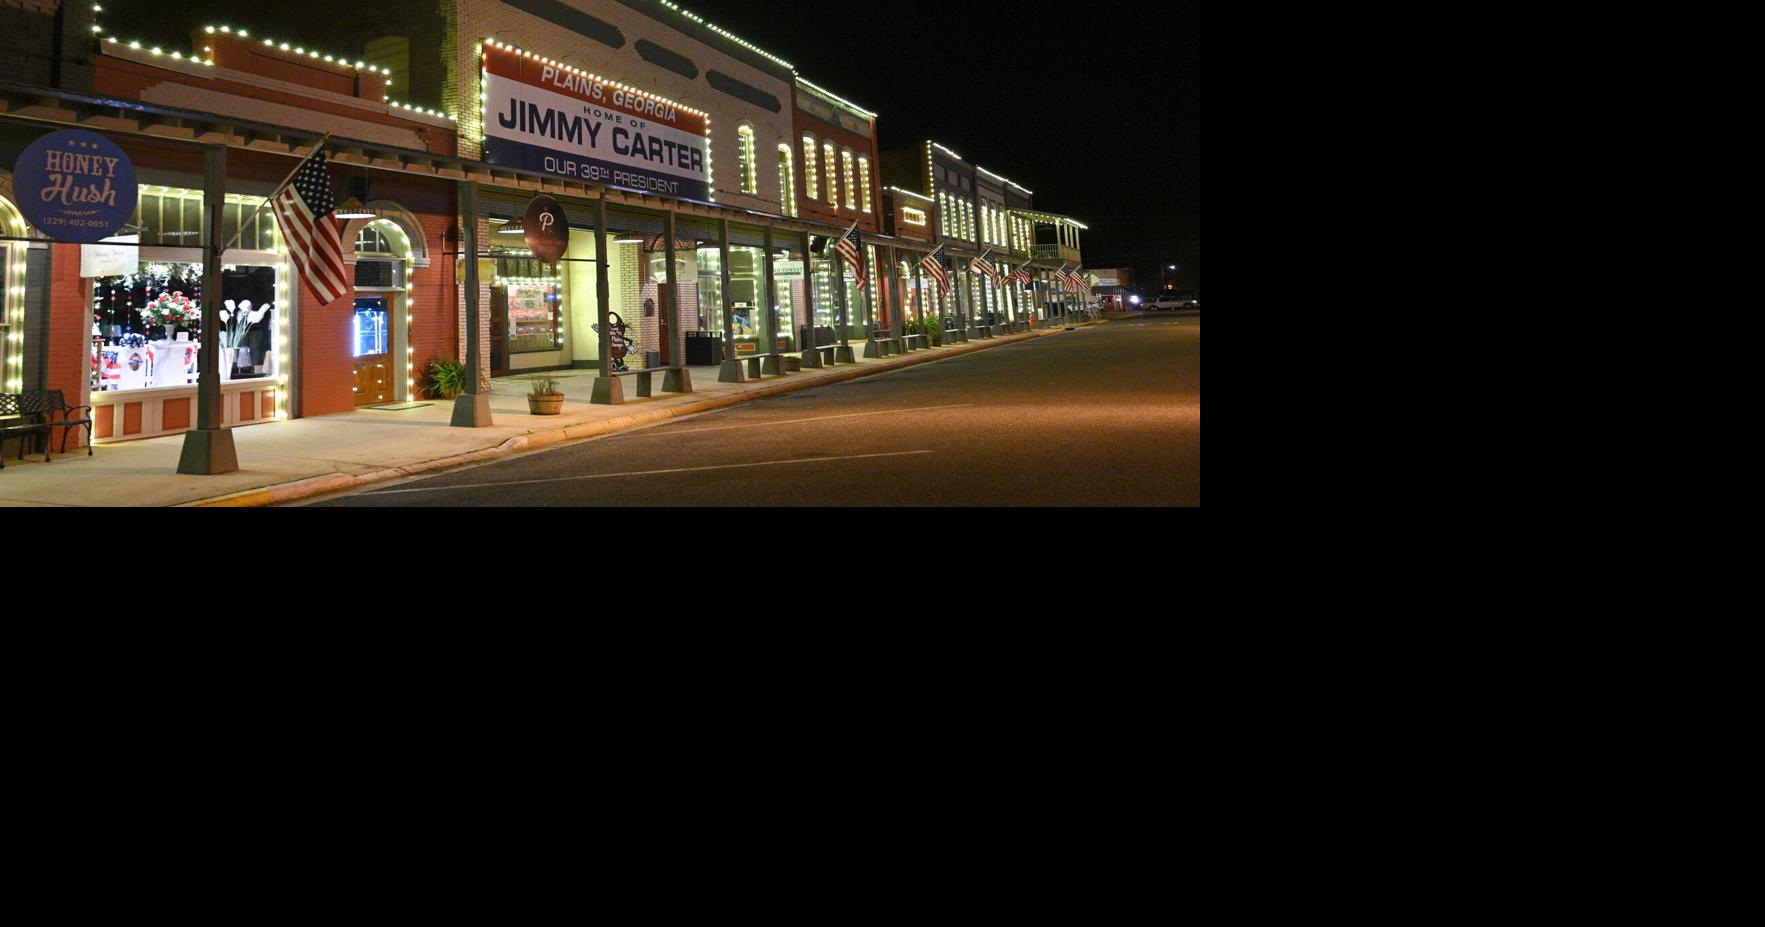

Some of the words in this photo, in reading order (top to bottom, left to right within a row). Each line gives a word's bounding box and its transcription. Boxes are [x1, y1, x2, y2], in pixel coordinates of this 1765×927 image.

[541, 66, 608, 104] PLAINS,
[612, 90, 677, 123] GEORGIA
[583, 105, 623, 124] HOME
[630, 120, 646, 130] OF
[498, 97, 602, 148] JIMMY
[612, 126, 704, 173] CARTER
[45, 150, 119, 177] HONEY
[544, 156, 577, 176] OUR
[580, 163, 610, 181] 39TH
[613, 170, 679, 195] PRESIDENT
[40, 173, 117, 206] Hush
[43, 217, 67, 227] (229)
[69, 218, 109, 228] 402-0051
[539, 212, 554, 231] P
